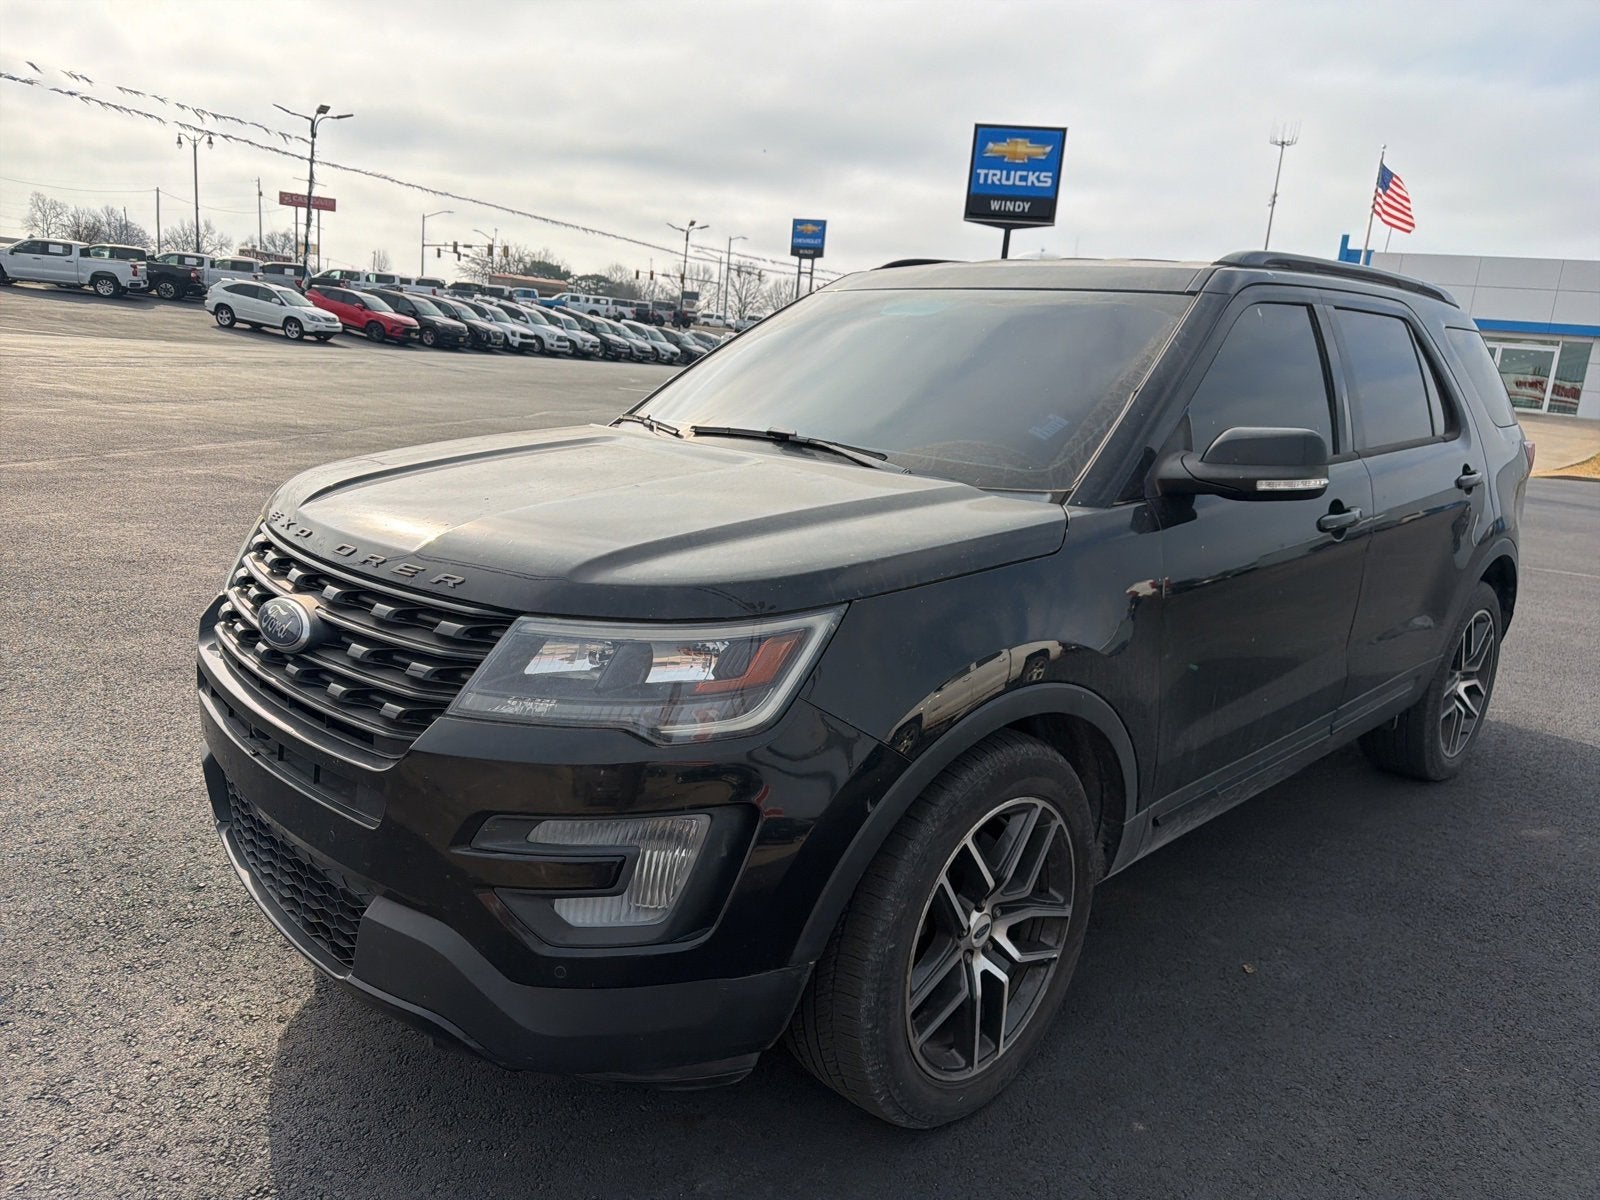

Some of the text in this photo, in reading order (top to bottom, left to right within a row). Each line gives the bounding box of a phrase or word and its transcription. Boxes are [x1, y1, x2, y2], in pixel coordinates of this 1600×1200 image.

[976, 168, 1053, 188] TRUCKS
[990, 199, 1032, 213] WINDY
[271, 510, 467, 590] EXPORER
[261, 604, 293, 640] Ford
